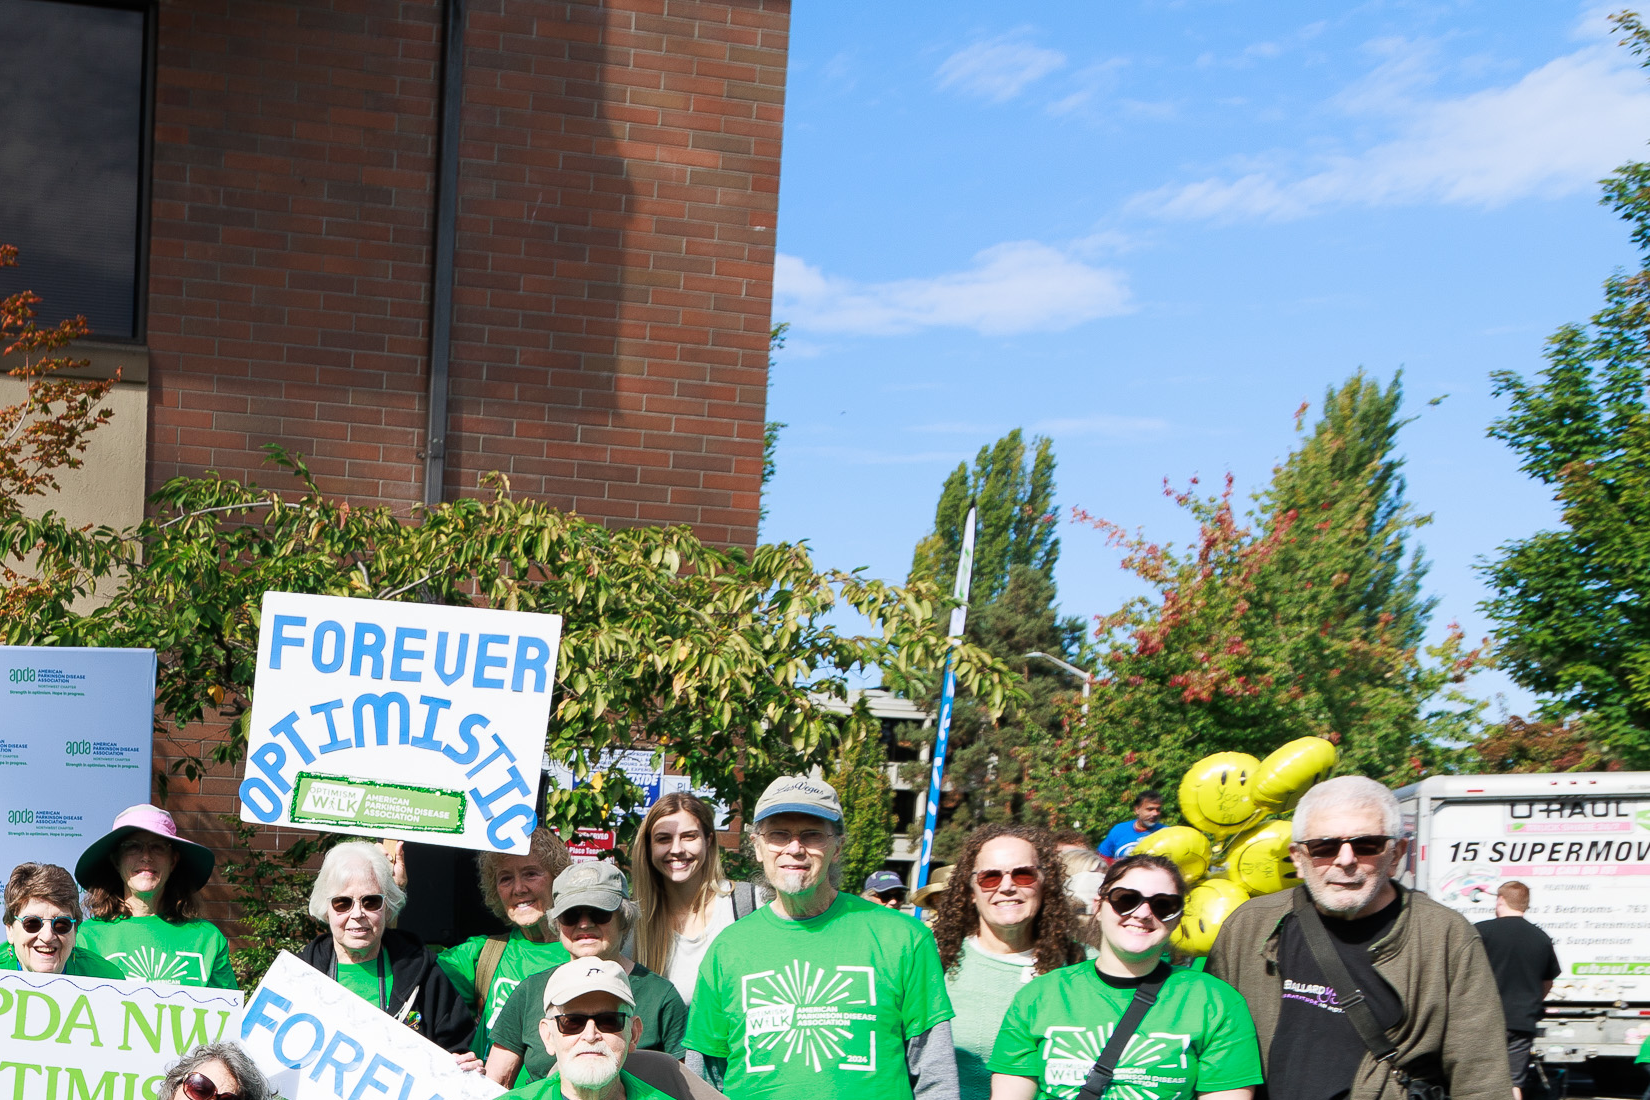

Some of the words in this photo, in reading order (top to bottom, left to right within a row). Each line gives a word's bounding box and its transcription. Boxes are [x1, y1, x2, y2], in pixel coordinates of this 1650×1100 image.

[269, 614, 550, 693] FOREVER
[10, 666, 36, 684] apda
[66, 739, 91, 756] apda
[238, 691, 538, 850] OPTIMISTIC
[309, 786, 356, 799] OPTIMISM
[773, 784, 795, 796] Las
[794, 781, 824, 795] Vegas
[366, 794, 410, 806] AMERICAN
[8, 808, 34, 826] apda
[363, 809, 420, 822] ASSOCIATION
[365, 801, 414, 814] PARKINSON
[414, 808, 450, 819] DISEASE
[797, 1012, 843, 1020] PARKINSON
[844, 1013, 877, 1021] DISEASE
[118, 1001, 230, 1056] NW
[847, 1055, 868, 1063] 2024
